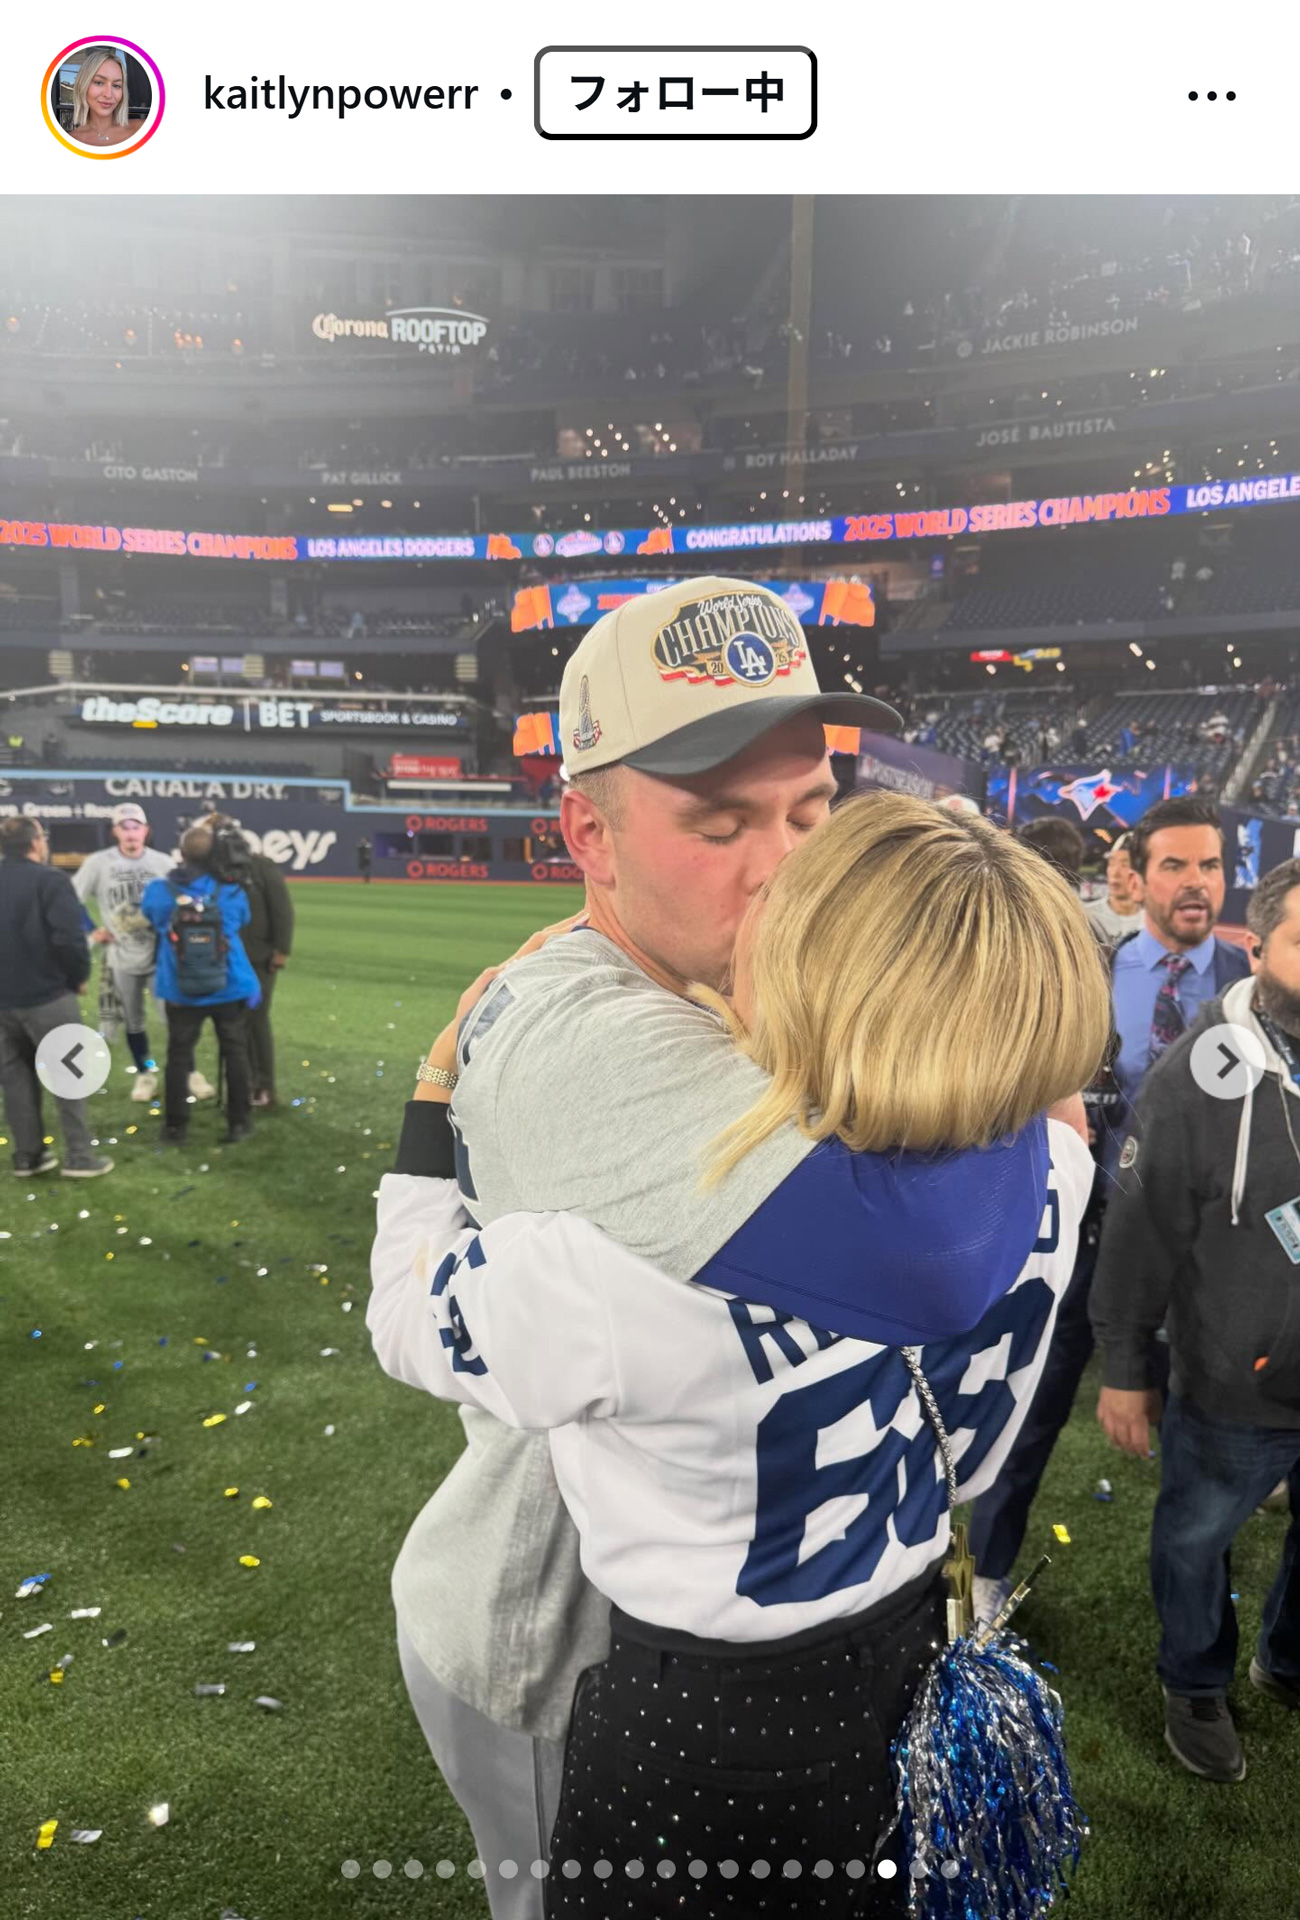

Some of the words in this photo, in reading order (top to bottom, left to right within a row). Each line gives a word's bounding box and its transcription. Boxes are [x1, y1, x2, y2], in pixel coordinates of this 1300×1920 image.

[312, 313, 389, 342] Corona
[391, 317, 487, 345] ROOFTOP
[981, 331, 1040, 354] JACKIE
[1044, 316, 1139, 344] ROBINSON
[1029, 417, 1117, 441] BAUTISTA
[103, 465, 137, 480] CITO
[141, 466, 198, 482] GASTON
[745, 453, 776, 468] ROY
[1186, 487, 1225, 509] LOS
[844, 514, 893, 542] 2025
[894, 508, 967, 538] WORLD
[968, 501, 1037, 532] SERIES
[1038, 488, 1171, 526] CHAMPIONS
[0, 520, 47, 546] 2025
[48, 524, 121, 551] WORLD
[122, 528, 187, 555] SERIES
[187, 532, 298, 560] CHAMPIONS
[308, 539, 335, 557] LOS
[336, 539, 402, 557] ANGELES
[403, 538, 474, 556] DODGERS
[686, 520, 832, 549] CONGRATULATIONS
[698, 598, 735, 616] World
[658, 604, 800, 667] CHAMPIONS
[734, 641, 769, 677] LA
[82, 696, 234, 725] theScore
[258, 702, 314, 729] BET
[423, 816, 488, 832] ROGERS
[425, 862, 489, 879] ROGERS
